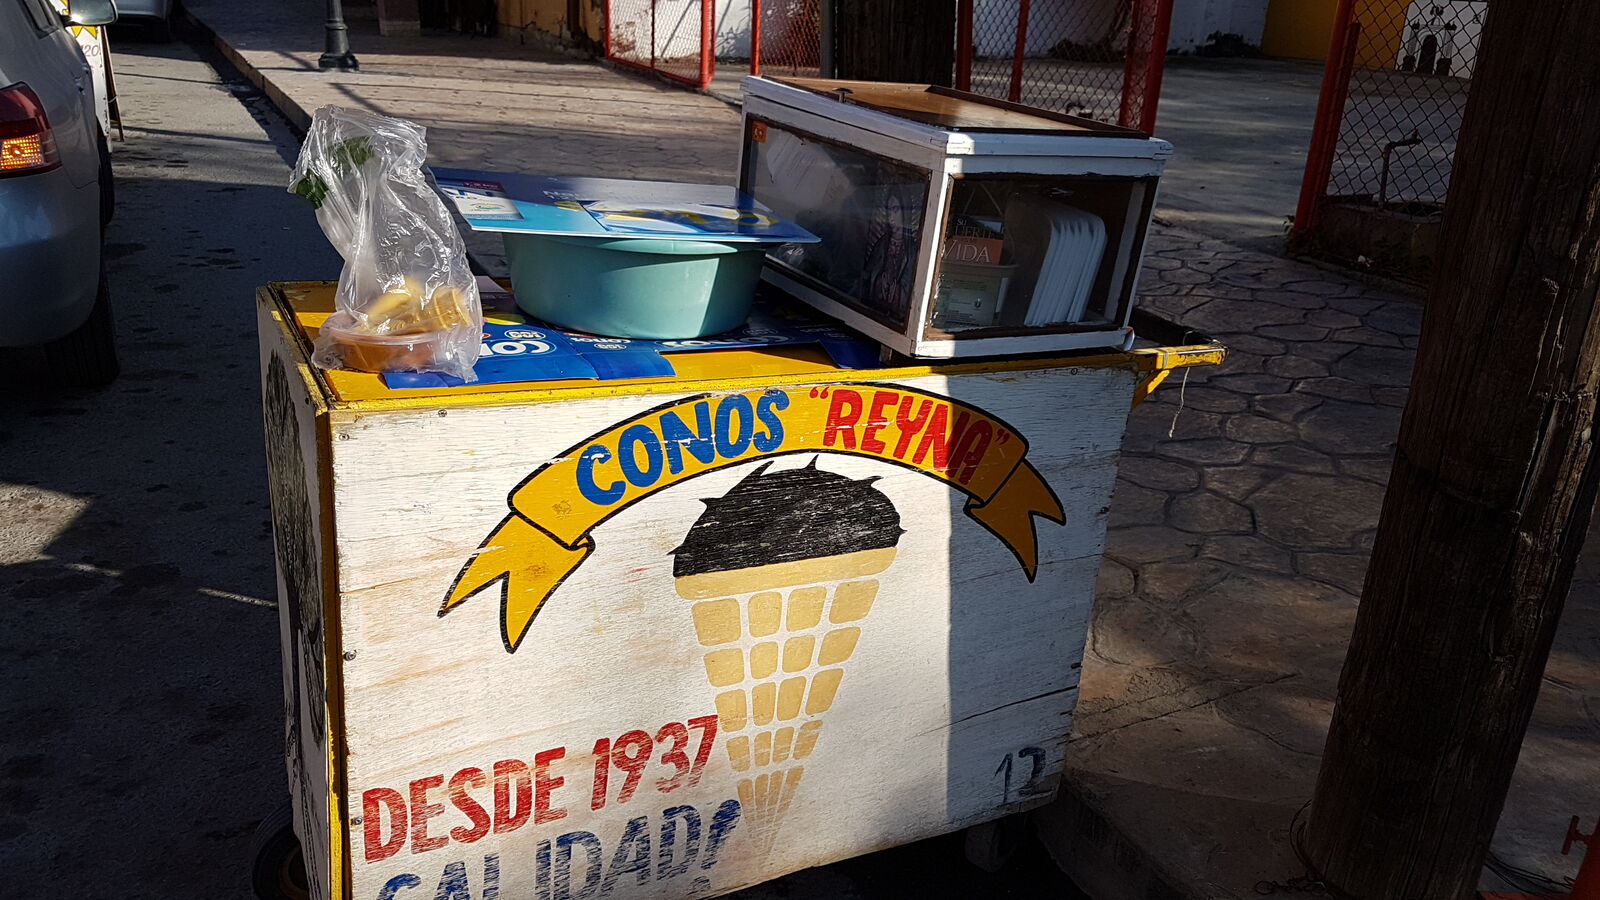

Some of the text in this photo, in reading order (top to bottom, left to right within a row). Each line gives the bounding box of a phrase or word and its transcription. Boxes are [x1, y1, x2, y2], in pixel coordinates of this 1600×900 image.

[943, 239, 992, 263] VIDA
[576, 386, 1010, 505] CONOS "REYNA"
[362, 714, 719, 864] DESDE 1937
